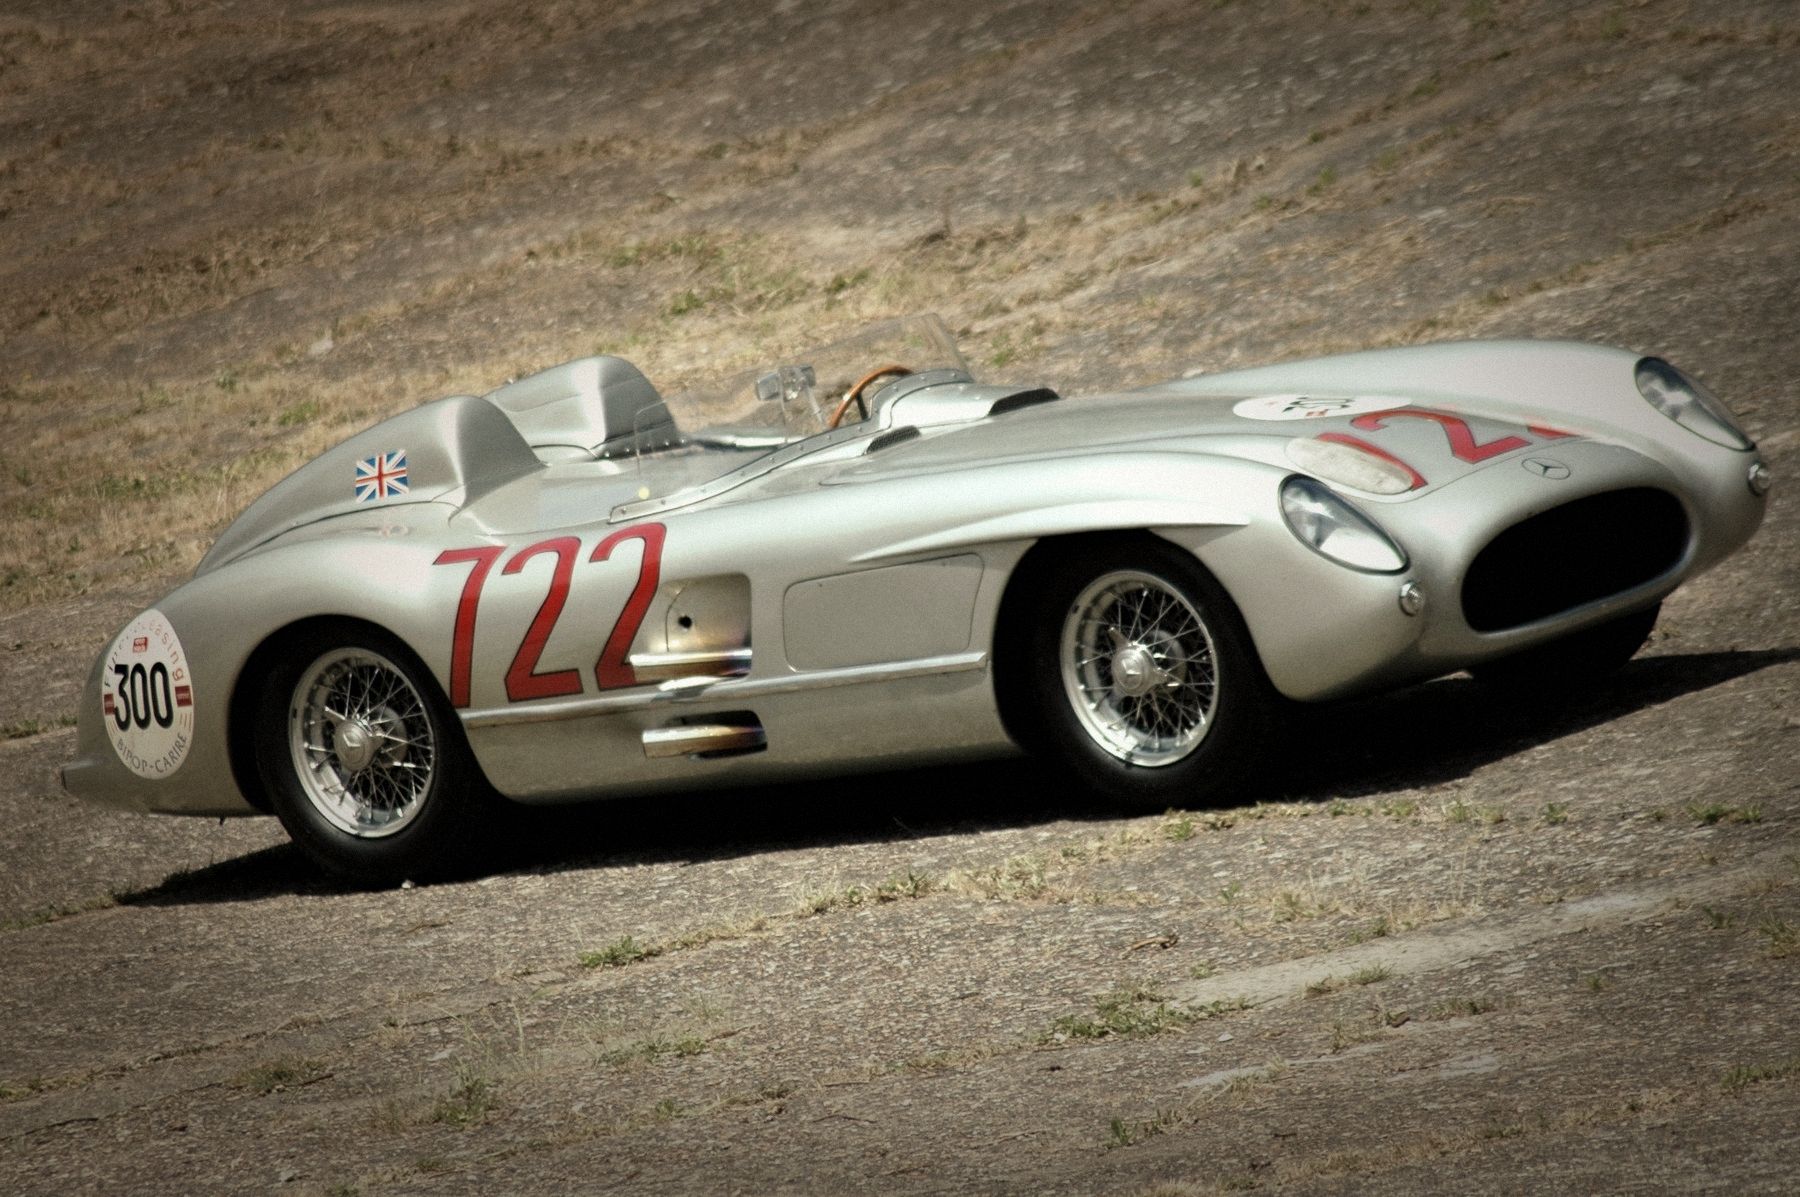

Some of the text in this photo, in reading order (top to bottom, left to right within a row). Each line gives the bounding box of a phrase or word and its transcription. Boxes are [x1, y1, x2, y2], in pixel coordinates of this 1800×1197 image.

[433, 522, 666, 708] 722
[114, 661, 174, 732] 300
[117, 732, 188, 774] BIPOP-CARIRE
